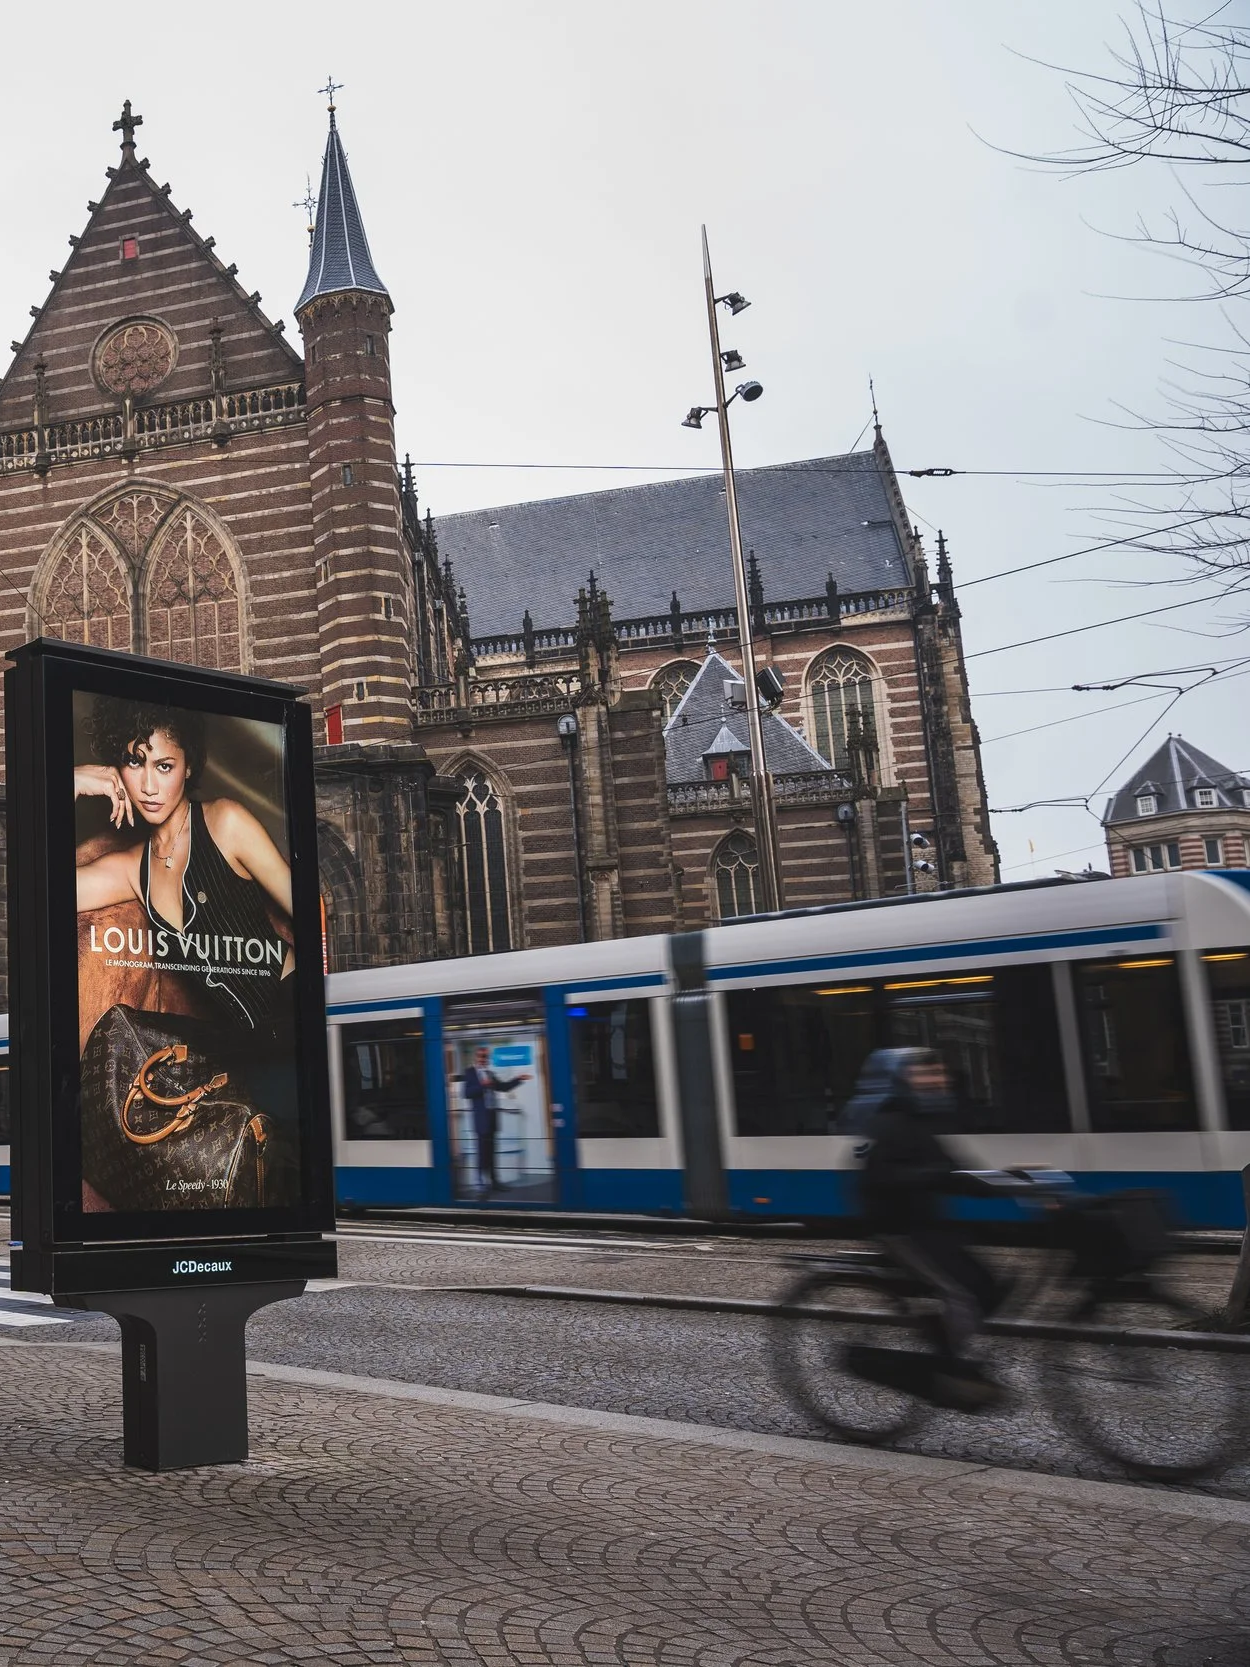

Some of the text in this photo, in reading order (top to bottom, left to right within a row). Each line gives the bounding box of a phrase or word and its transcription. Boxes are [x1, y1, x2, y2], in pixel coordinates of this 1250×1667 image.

[90, 925, 169, 957] LOUIS
[176, 932, 283, 965] VUITTON
[155, 962, 200, 972] TRANSCENDING
[201, 965, 241, 975] GENERATIONS
[241, 968, 257, 976] SINCE
[165, 1180, 177, 1191] Le
[178, 1179, 206, 1193] Speedy
[211, 1179, 229, 1190] 1930
[172, 1260, 232, 1274] JCDecaux
